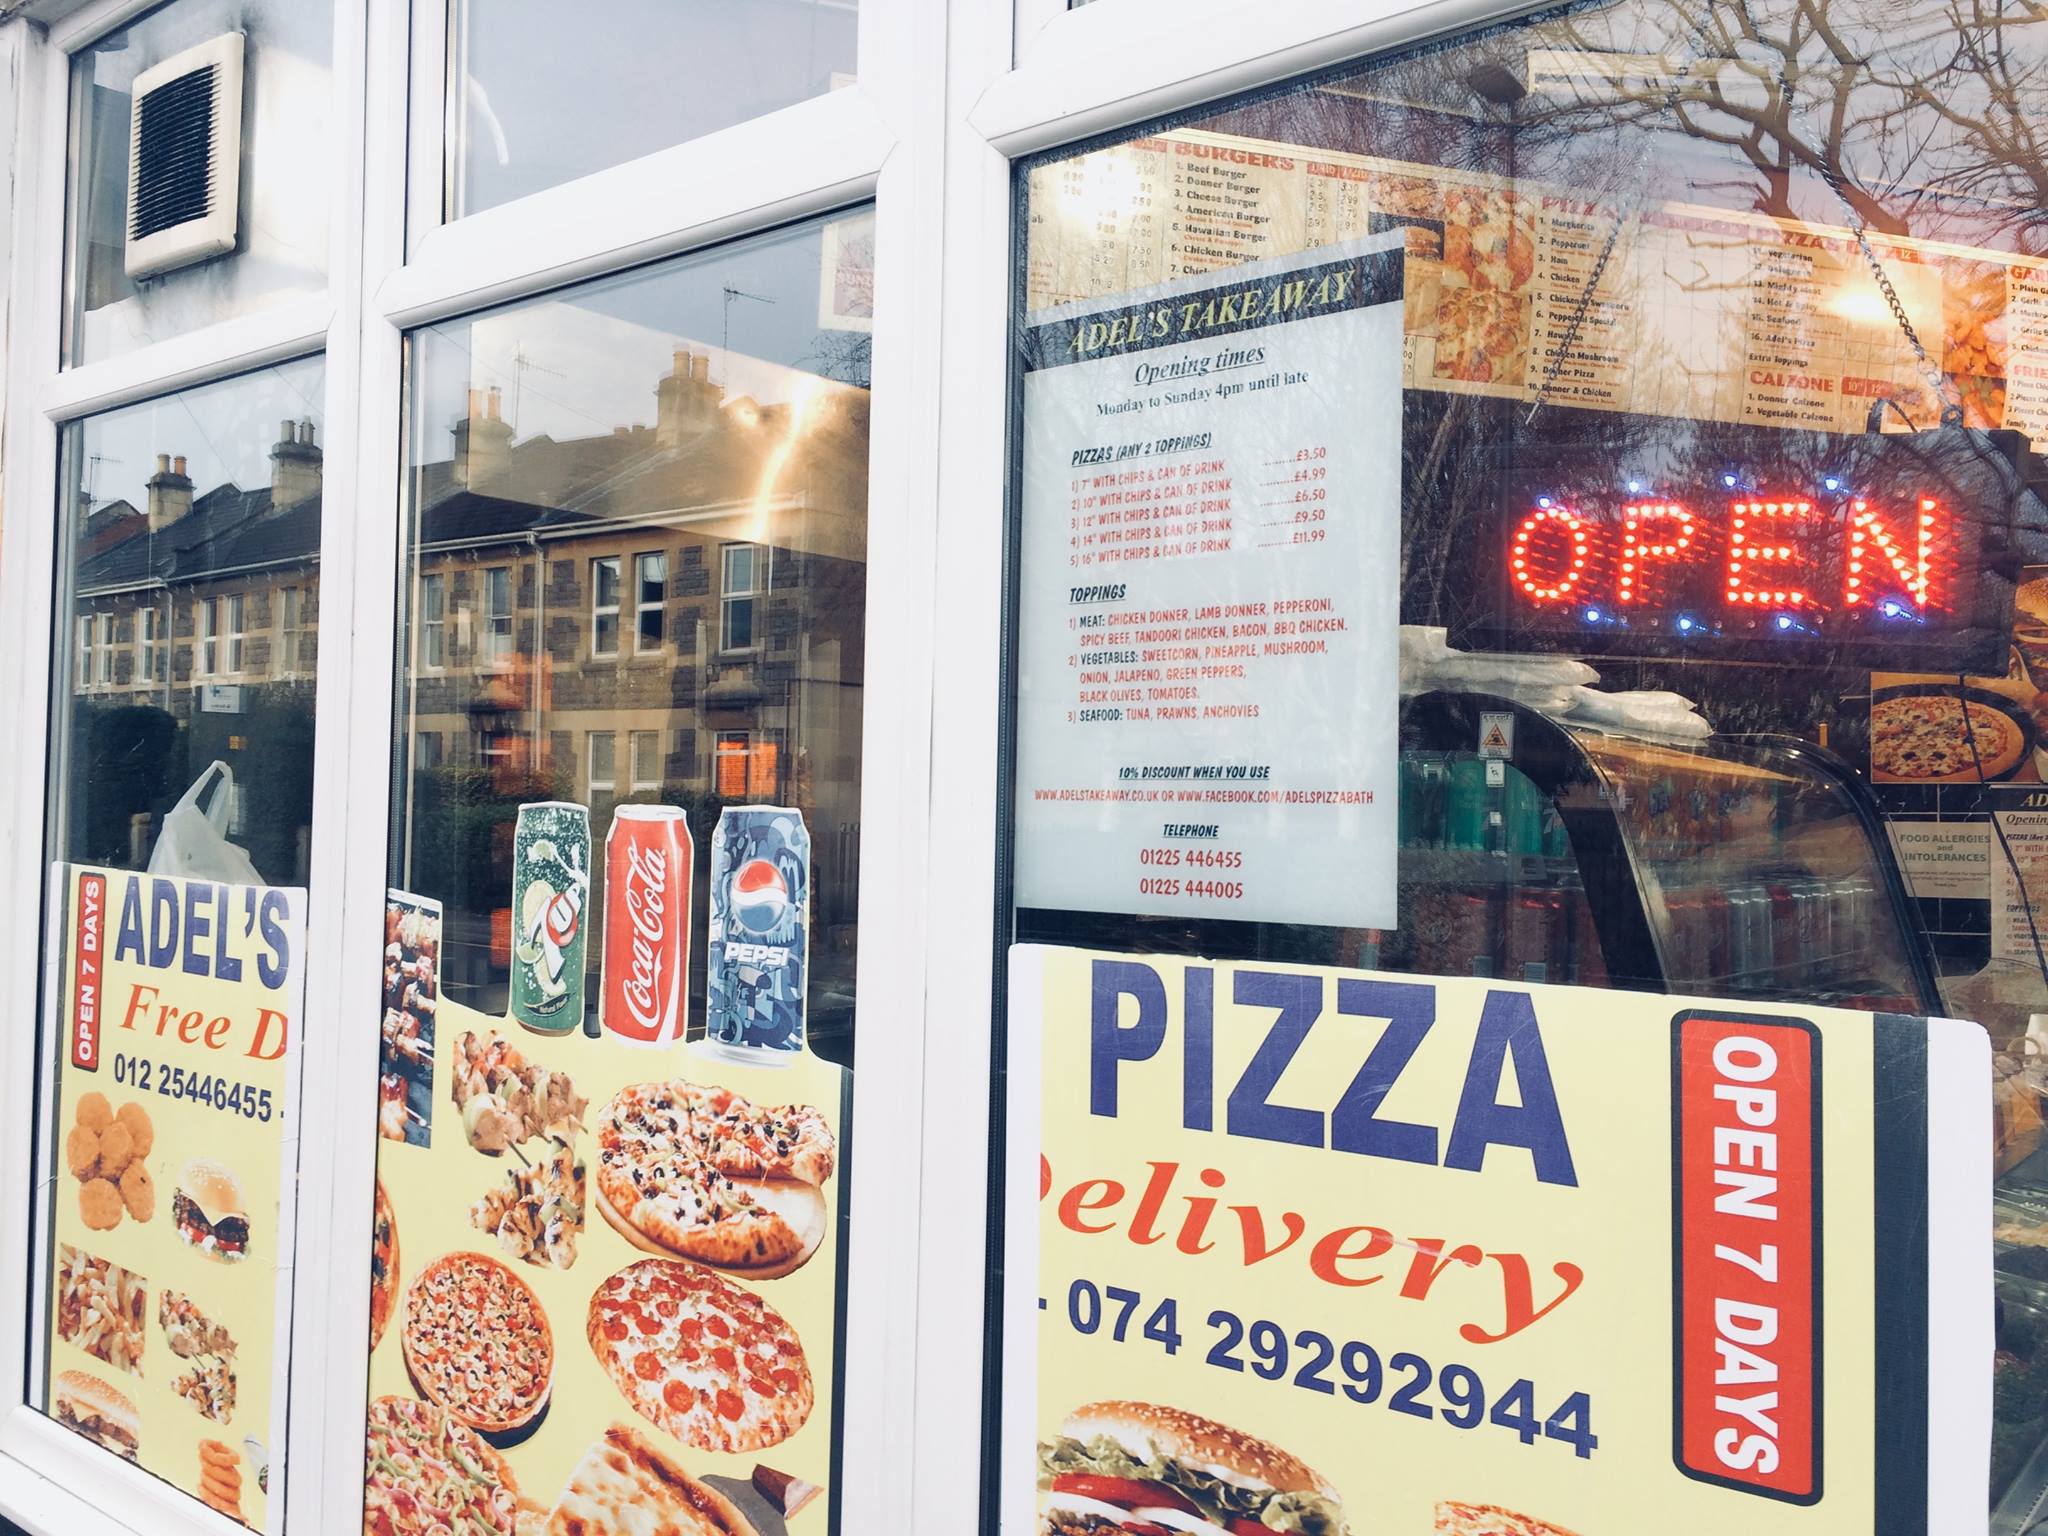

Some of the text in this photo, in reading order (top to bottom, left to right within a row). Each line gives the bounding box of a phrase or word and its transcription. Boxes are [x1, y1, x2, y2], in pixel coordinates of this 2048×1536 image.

[1175, 143, 1294, 171] BURGERS
[1184, 245, 1223, 257] Chicken
[1066, 269, 1356, 354] ADEL'S TAKEAWAY
[1135, 347, 1265, 386] Opening times
[1096, 371, 1309, 417] Monday to Sunday 4pm until late
[1750, 371, 1834, 393] CALZONE
[1072, 432, 1212, 466] PIZZAS (ANY 2 TOPPINGS)
[1094, 474, 1115, 488] WITH
[1118, 471, 1145, 486] CHIPS
[1148, 470, 1154, 482] &
[1157, 467, 1176, 480] CAN
[1180, 464, 1191, 477] OF
[1195, 460, 1225, 475] DRINK
[1100, 493, 1122, 506] WITH
[1125, 489, 1151, 503] CHIPS
[1154, 488, 1161, 499] &
[1164, 485, 1182, 499] CAN
[1187, 483, 1198, 496] OF
[1202, 478, 1232, 494] DRINK
[1098, 511, 1121, 525] WITH
[1124, 508, 1150, 522] CHIPS
[1153, 507, 1160, 519] &
[1163, 504, 1182, 518] CAN
[1185, 502, 1197, 515] OF
[1200, 499, 1231, 514] DRINK
[1100, 531, 1122, 544] WITH
[1125, 527, 1151, 541] CHIPS
[1154, 526, 1161, 538] &
[1164, 524, 1183, 538] CAN
[1187, 522, 1198, 535] OF
[1202, 518, 1232, 533] DRINK
[1098, 550, 1120, 563] WITH
[1124, 546, 1150, 561] CHIPS
[1153, 546, 1159, 558] &
[1163, 544, 1181, 557] CAN
[1185, 542, 1197, 554] OF
[1200, 539, 1231, 552] DRINK
[1511, 495, 1938, 606] OPEN
[1069, 584, 1126, 603] TOPPINGS
[1080, 615, 1105, 628] MEAT:
[1108, 611, 1146, 626] CHICKEN
[1150, 608, 1191, 623] DONNER,
[1195, 606, 1221, 620] LAMB
[1225, 603, 1269, 617] DONNER,
[1273, 598, 1334, 614] PEPPERONI,
[1080, 633, 1105, 647] SPICY
[1135, 629, 1181, 643] TANDOORI
[1185, 625, 1229, 640] CHICKEN,
[1232, 623, 1270, 637] BACON,
[1274, 621, 1296, 635] BBQ
[1299, 618, 1348, 633] CHICKEN.
[1080, 651, 1138, 665] VEGETABLES:
[1142, 647, 1201, 662] SWEETCORN,
[1205, 644, 1260, 659] PINEAPPLE,
[1264, 640, 1328, 655] MUSHROOM,
[1080, 671, 1111, 684] ONION,
[1167, 667, 1197, 680] GREEN
[1201, 665, 1247, 679] PEPPERS,
[1080, 690, 1108, 702] BLACK
[1080, 709, 1123, 722] SEAFOOD:
[1126, 707, 1153, 722] TUNA,
[1157, 706, 1200, 720] PRAWNS,
[1203, 705, 1259, 719] ANCHOVIES
[1118, 765, 1270, 779] 10% DISCOUNT WHEN YOU USE
[1035, 789, 1373, 804] WWW.ADELSTAKEAWAY.CO.UK OR WWW.FACEBOOK.COM/ADELSPIZZABATH
[1163, 824, 1219, 838] TELEPHONE
[2006, 814, 2048, 826] Openin
[1900, 834, 1991, 844] FOOD ALLERGIES
[1937, 843, 1953, 851] and
[1140, 849, 1242, 868] 01225 446455
[1904, 853, 1986, 862] INTOLERANCES
[1140, 878, 1243, 899] 01225 444005
[114, 876, 290, 990] ADEL'S
[722, 941, 789, 967] PEPSI
[78, 881, 98, 1061] OPEN 7 DAYS
[119, 983, 231, 1049] Free
[1089, 958, 1579, 1188] PIZZA
[114, 1053, 272, 1123] 012 25446455
[1040, 1150, 1585, 1345] elivery
[1711, 1035, 1780, 1475] OPEN 7 DAYS
[1067, 1277, 1598, 1460] 074 29292944
